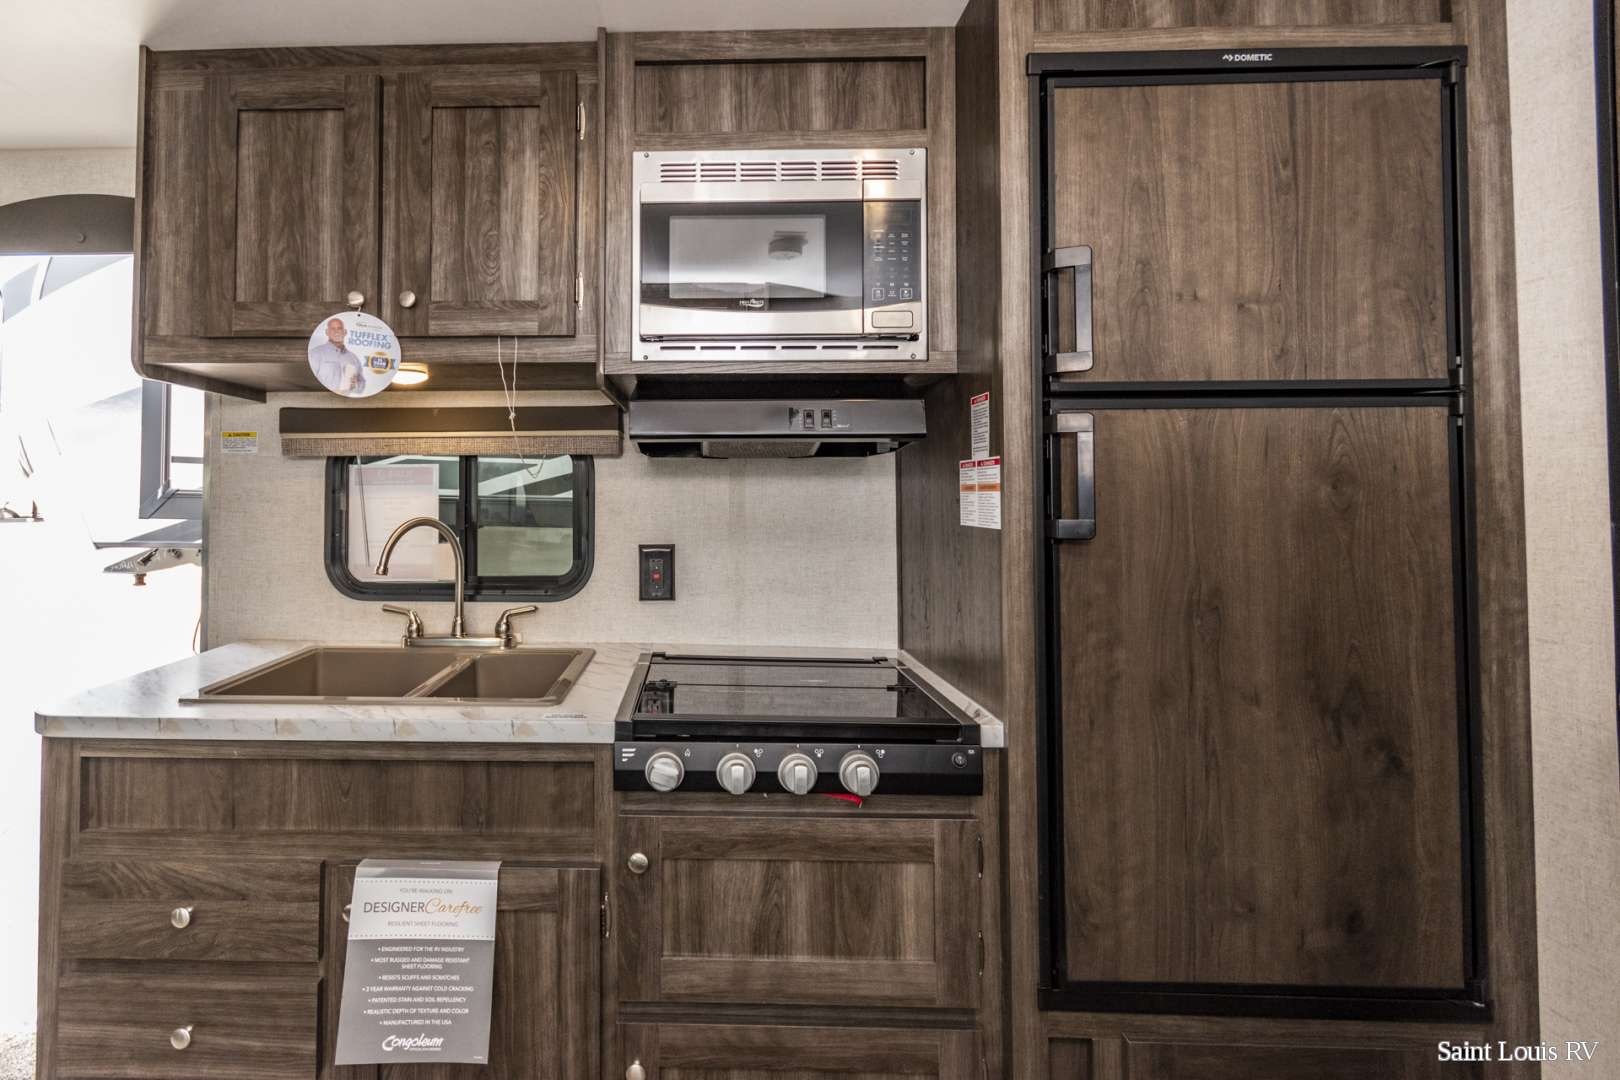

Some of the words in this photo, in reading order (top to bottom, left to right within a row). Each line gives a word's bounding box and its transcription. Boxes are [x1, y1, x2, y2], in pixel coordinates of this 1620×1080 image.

[1234, 53, 1272, 62] DOMETIC
[350, 330, 387, 342] TUFFLEX
[348, 338, 391, 350] ROOFING
[382, 1033, 444, 1052] Congoleum
